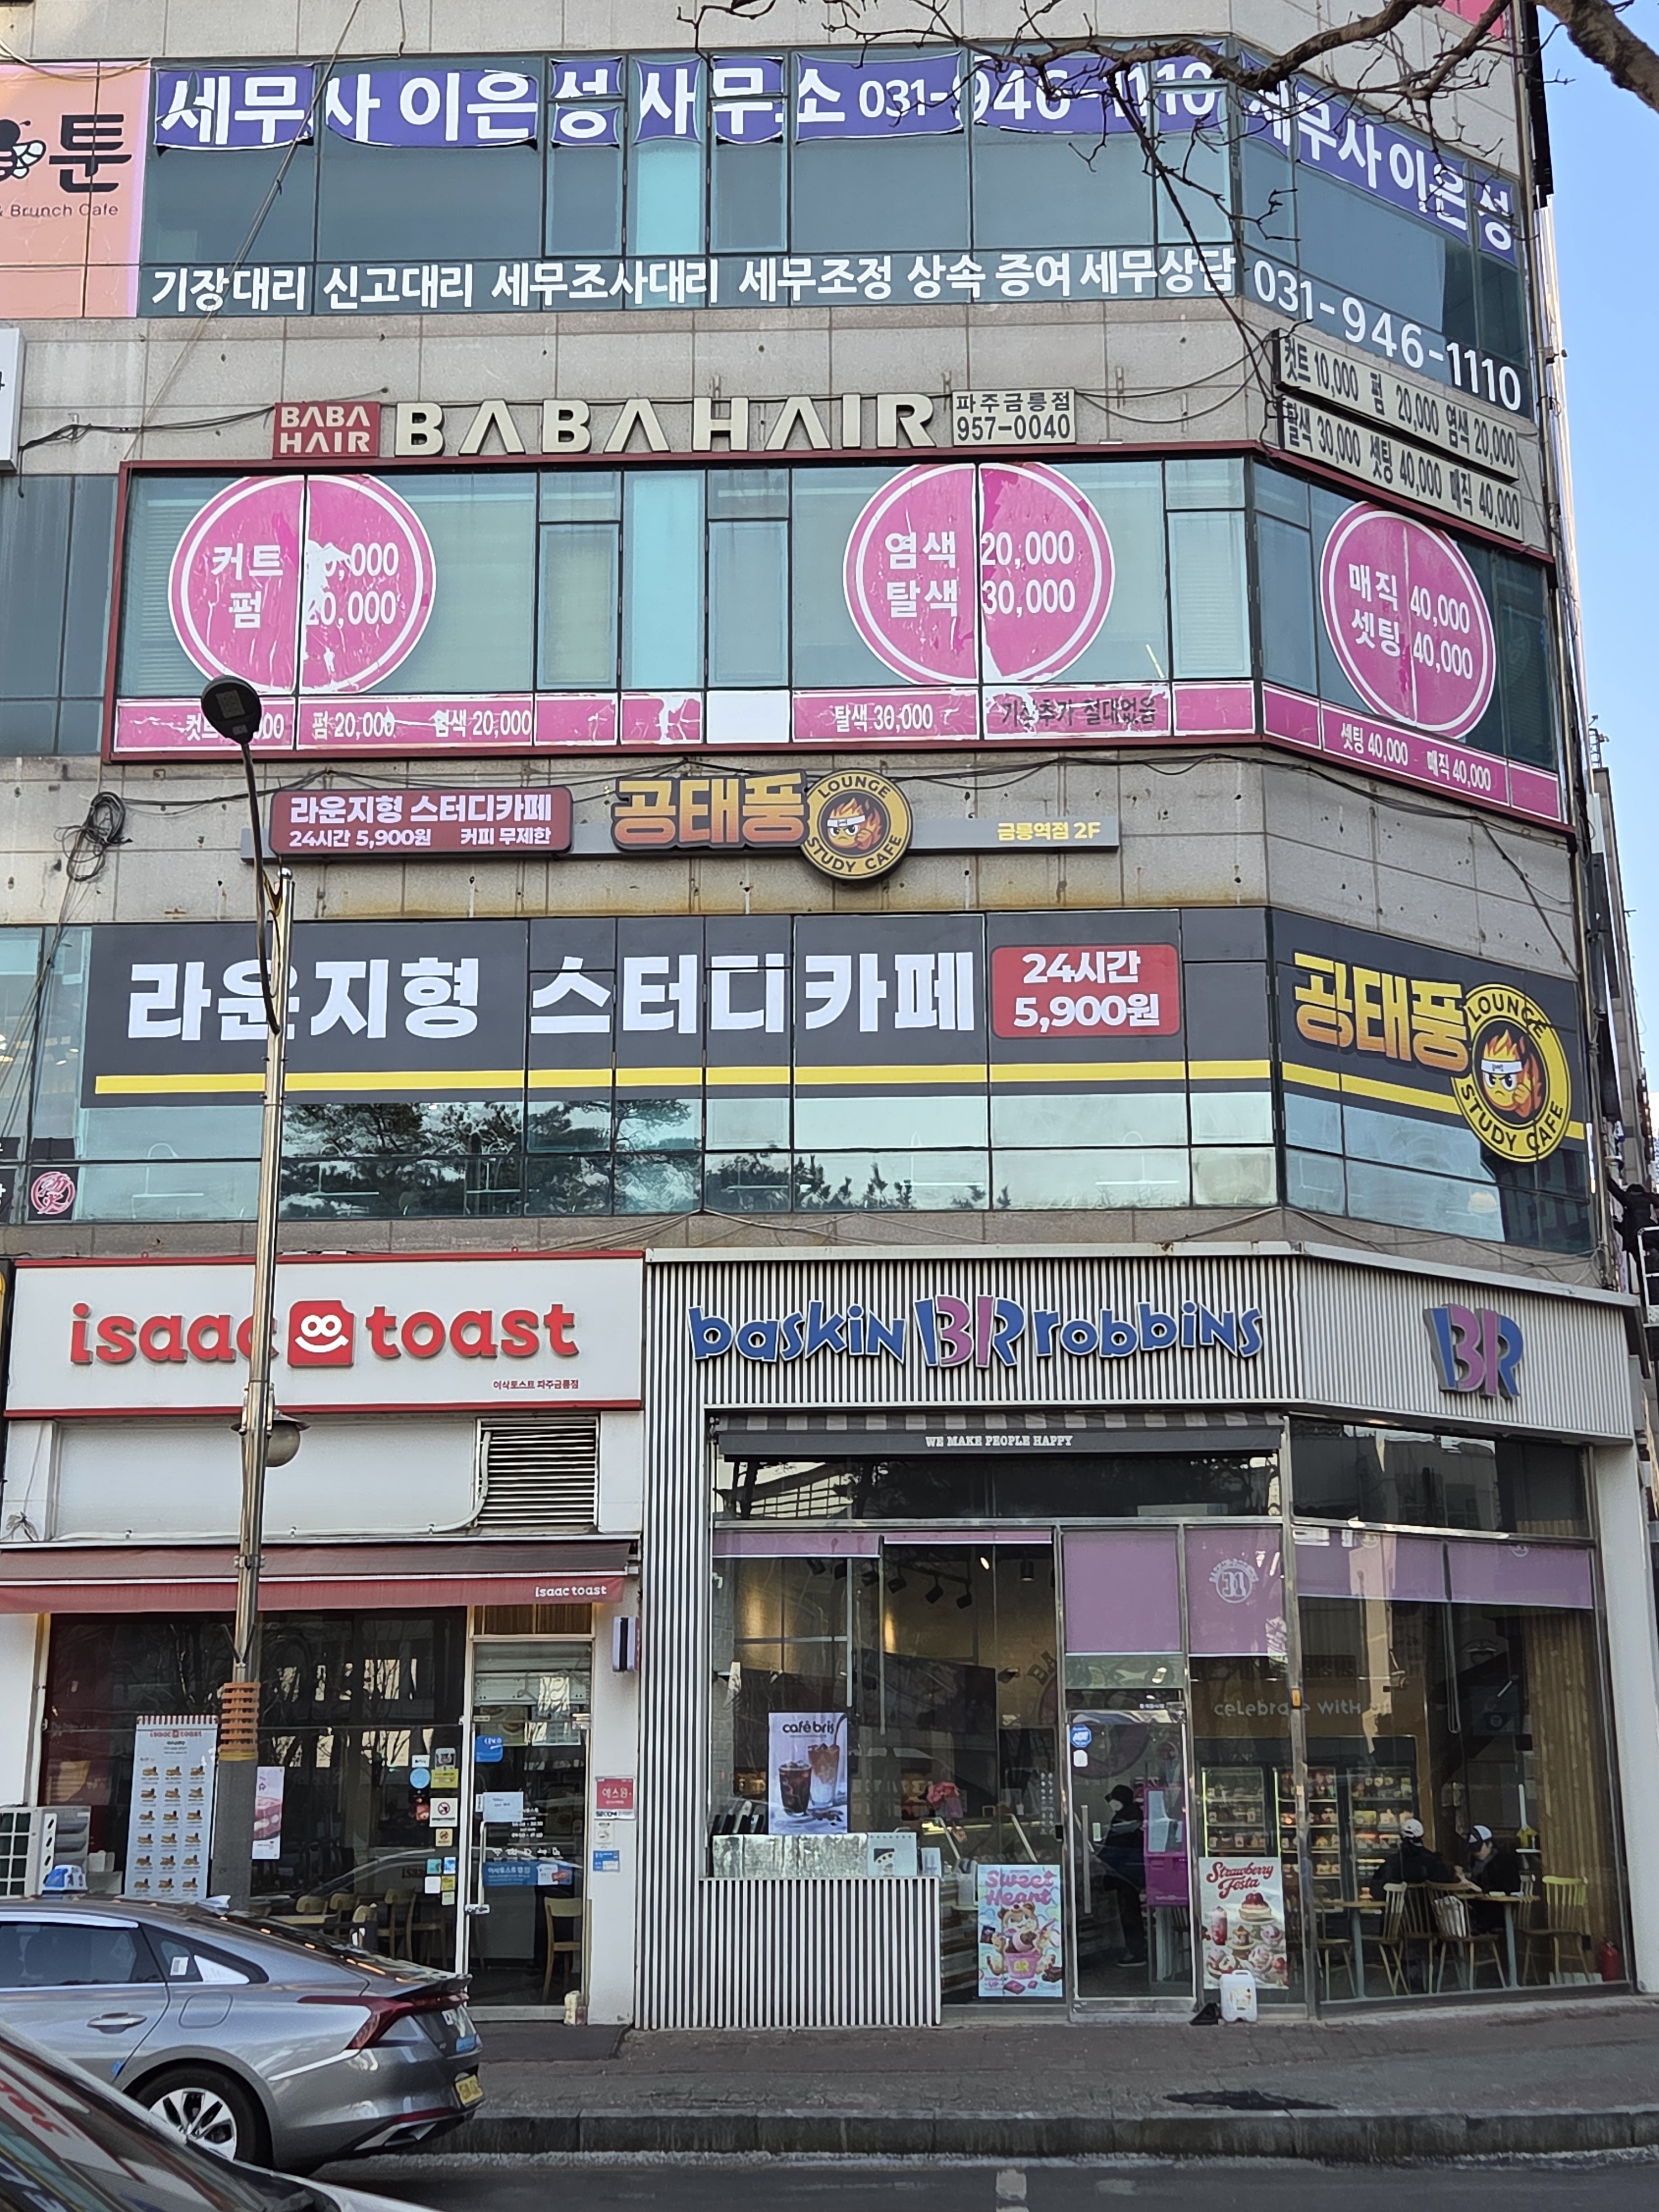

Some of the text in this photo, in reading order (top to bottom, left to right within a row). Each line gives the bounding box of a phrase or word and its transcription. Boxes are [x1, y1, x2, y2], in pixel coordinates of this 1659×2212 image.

[160, 58, 1218, 145] 세무사 이은성 사무소 031-946-1110
[49, 114, 132, 193] 툰
[1249, 79, 1512, 251] 세무사 이은성
[11, 203, 118, 217] Brunch Cafe
[152, 248, 1237, 312] 기장대리 신고대리 세무조사대리 세무조정 상속 증여 세무상담
[1254, 260, 1521, 411] 031-946-1110
[281, 407, 370, 427] BABA
[956, 392, 1071, 413] 파주금릉점
[1314, 351, 1359, 402] 10,000
[1396, 385, 1438, 435] 20,000
[1474, 418, 1515, 468] 20,000
[280, 431, 370, 454] HAIR
[394, 393, 937, 456] BABA HAIR
[957, 414, 1071, 441] 957-0040
[1318, 416, 1361, 467] 30,000
[1400, 450, 1442, 499] 40,000
[1479, 482, 1520, 530] 40,000
[211, 542, 399, 580] 커트 0,000
[885, 530, 1075, 570] 염색 20,000
[229, 591, 263, 628] 펌
[886, 578, 1075, 617] 탈색 30,000
[1348, 564, 1470, 634] 매직 40,000
[1352, 609, 1473, 680] 셋팅 40,000
[312, 711, 328, 740] 펌
[335, 711, 395, 739] 20,000
[472, 710, 531, 738] 20,000
[835, 703, 933, 732] 탈색 30,000
[1341, 722, 1491, 792] 셋팅 40,000 매직 40,000
[817, 775, 891, 800] LOUNGE
[291, 794, 551, 823] 라운지형 스터디카페
[614, 773, 805, 844] 공태풍
[289, 827, 551, 849] 24시간 5,900원 커피 무제한
[998, 822, 1100, 841] 금릉역점 2F
[806, 833, 903, 874] STUDY CAFE
[1022, 950, 1141, 984] 24시간
[128, 951, 974, 1041] 라운지형 스터디카페
[1014, 994, 1160, 1033] 5,900원
[1294, 952, 1469, 1073] 공태풍
[1468, 993, 1547, 1040] LOUNGE
[1461, 1083, 1563, 1152] STUDY CAFE
[366, 1302, 580, 1359] toast
[493, 1380, 535, 1390] 이삭토스트
[925, 1436, 1073, 1447] WE MAKE PEOPLE HAPPY
[571, 1585, 607, 1595] toast
[1214, 1699, 1311, 1717] celebrae
[985, 1870, 1057, 1888] Sweet
[1206, 1861, 1274, 1883] Strawberry
[984, 1888, 1051, 1906] Heart
